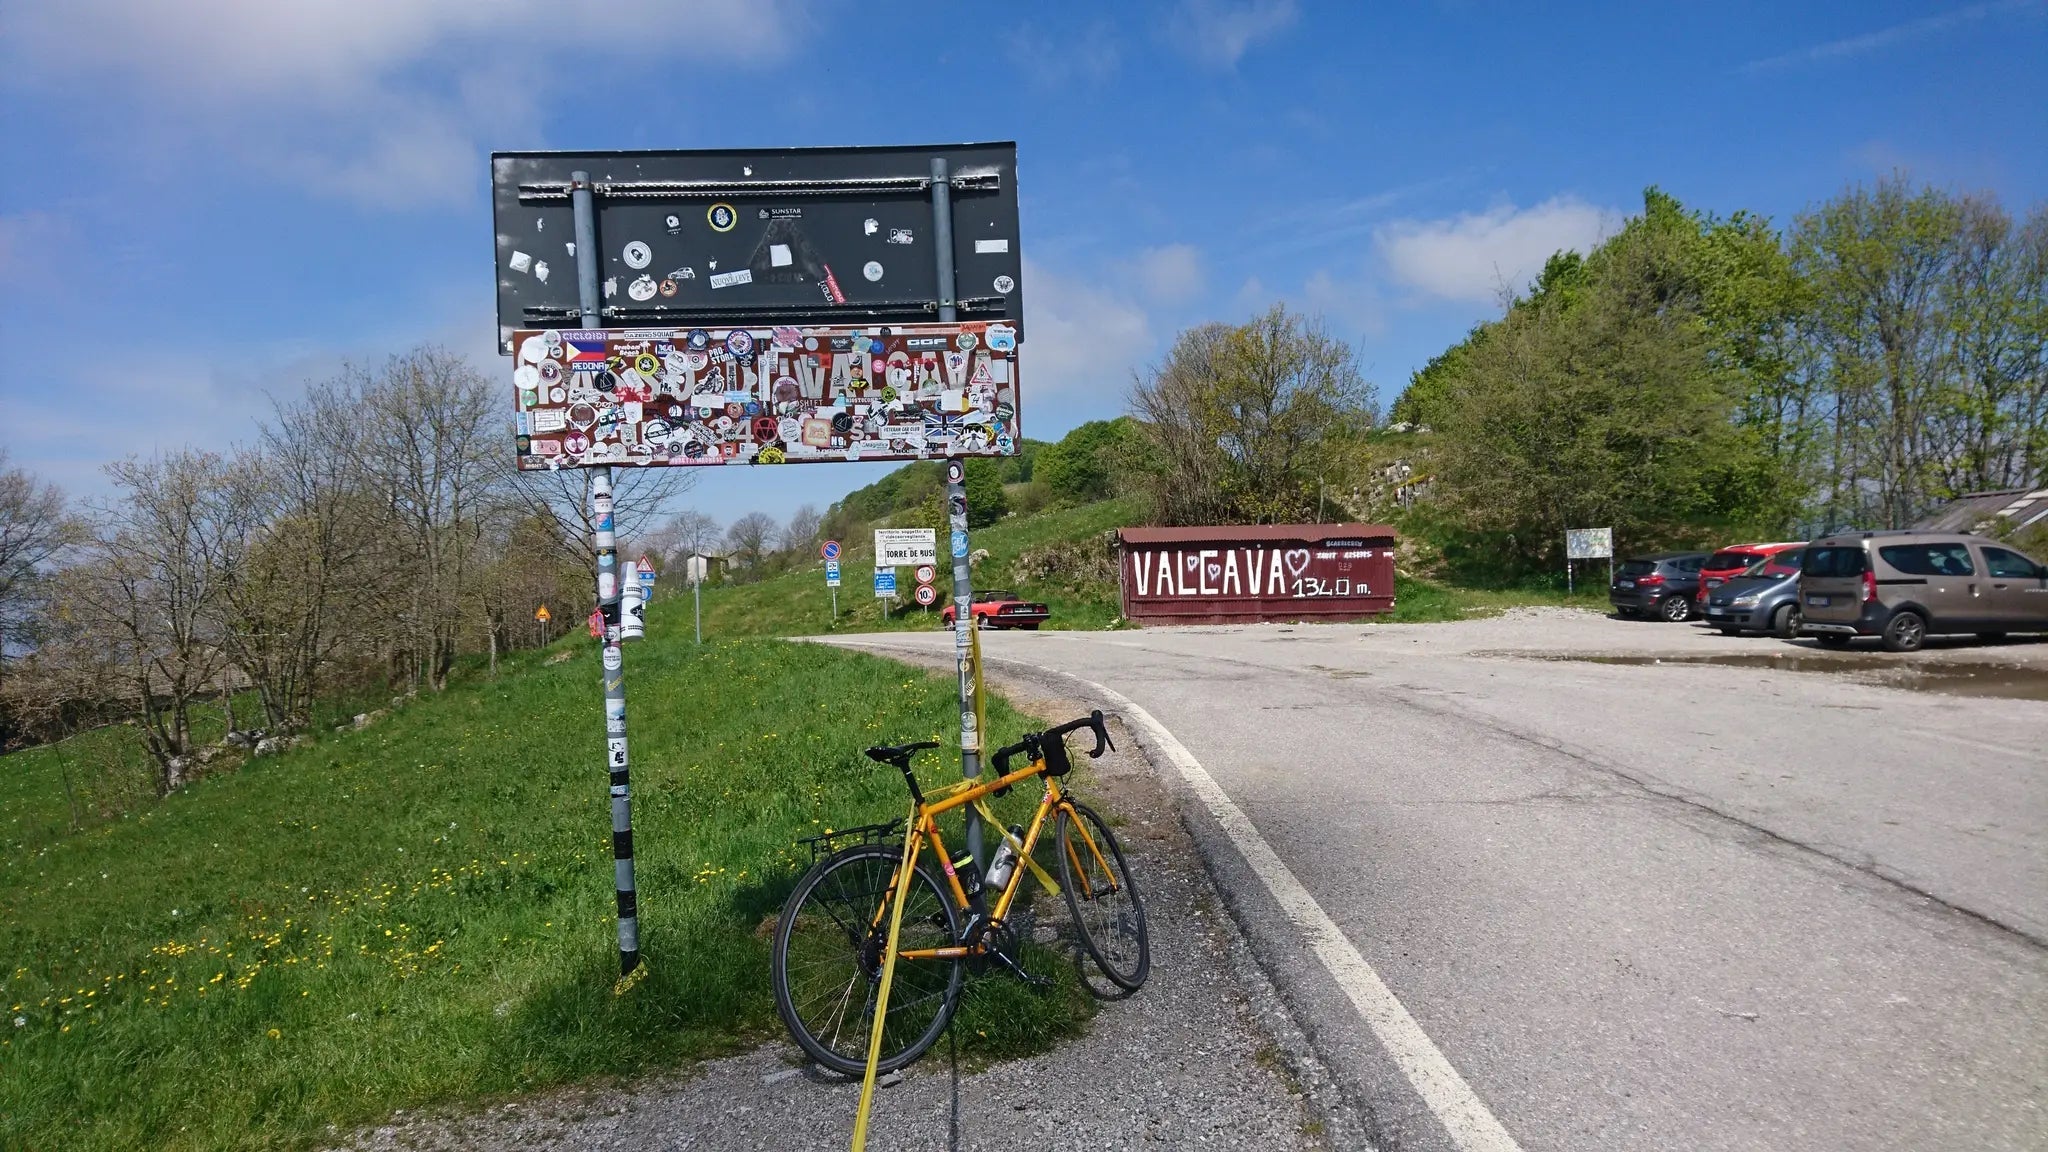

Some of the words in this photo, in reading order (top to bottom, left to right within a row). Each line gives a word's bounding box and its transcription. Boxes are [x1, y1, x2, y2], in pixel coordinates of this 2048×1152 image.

[561, 332, 608, 340] CICLOIDI
[572, 361, 606, 371] REDONA
[537, 357, 696, 405] PAO
[886, 550, 908, 558] TORRE
[909, 549, 918, 558] DE
[1132, 548, 1286, 596] VALCAVA
[1291, 577, 1350, 598] 1340
